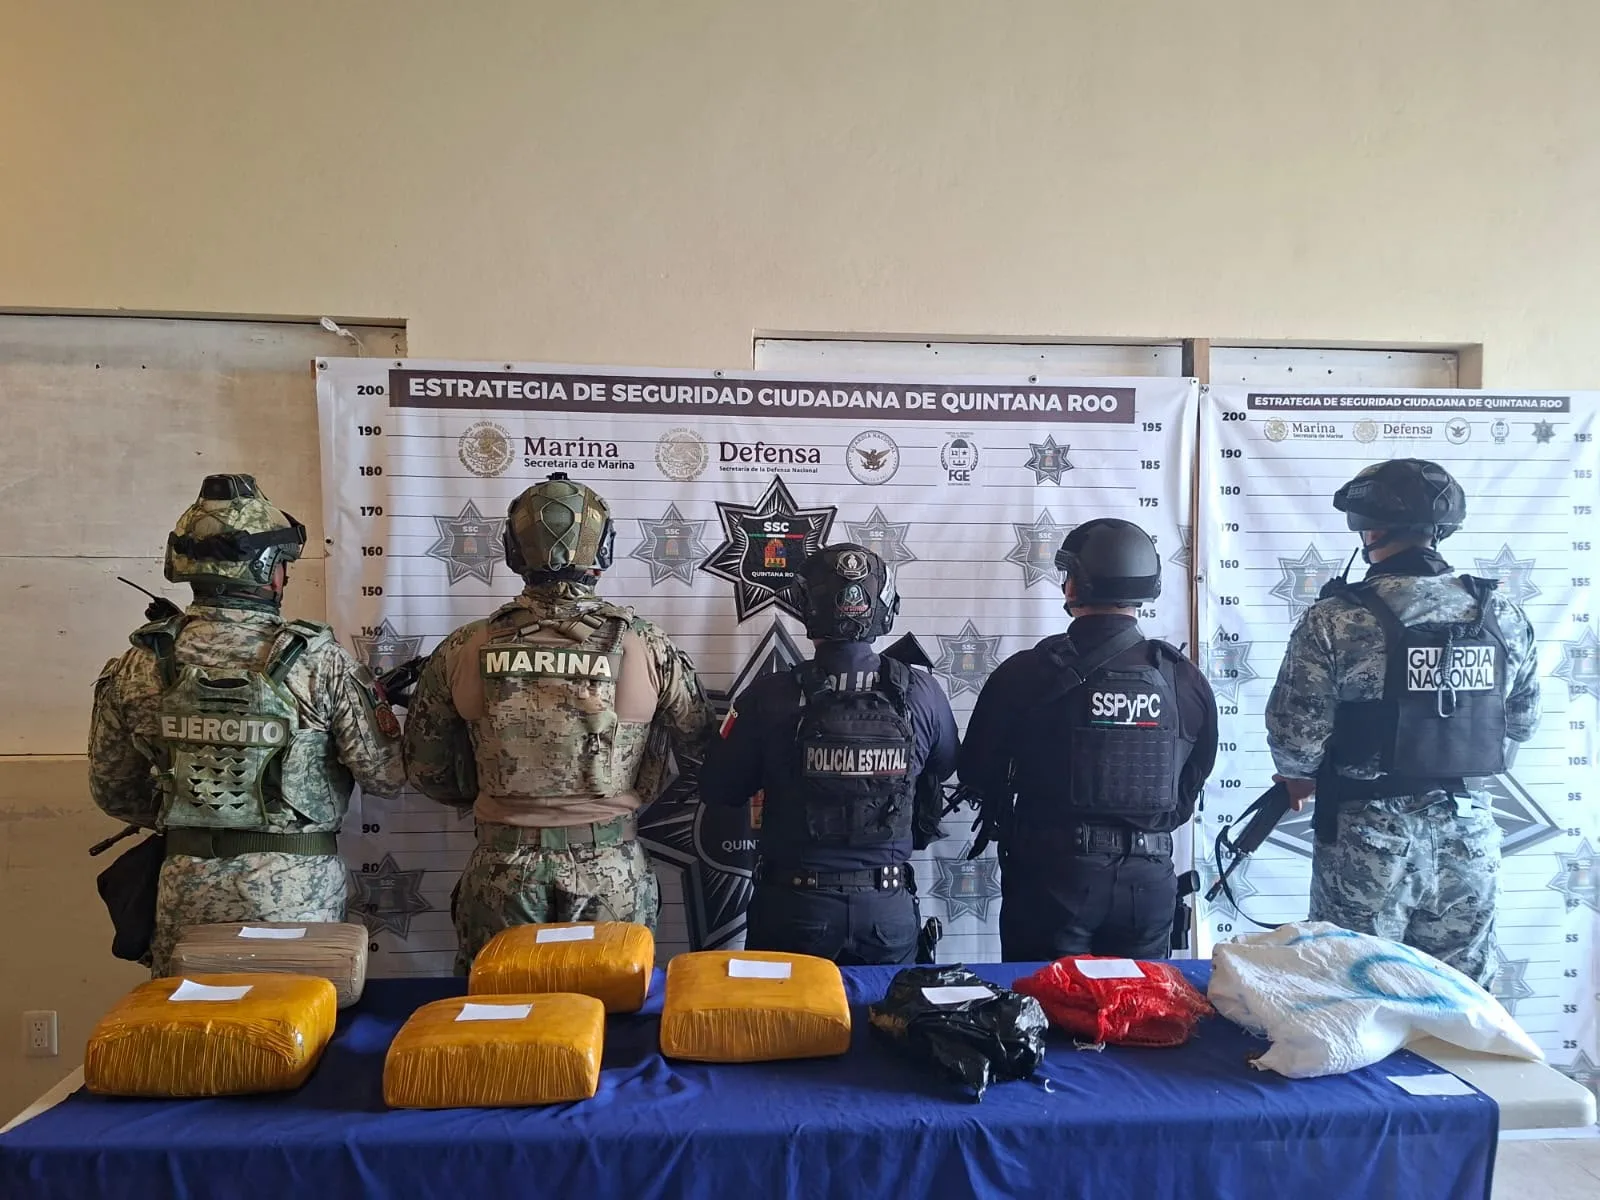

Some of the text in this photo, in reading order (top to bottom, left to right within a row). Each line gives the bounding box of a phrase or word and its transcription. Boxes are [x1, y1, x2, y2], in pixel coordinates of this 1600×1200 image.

[357, 385, 384, 395] 200
[409, 378, 1118, 413] ESTRATEGIA DE SEGURIDAD CIUDADANA DE QUINTANA ROO
[1255, 396, 1563, 409] ESTRATEGIA DE SEGURIDAD CIUDADANA DE QUINTANA ROO
[1222, 412, 1246, 421] 200
[358, 426, 381, 435] 190
[1142, 422, 1162, 432] 195
[1292, 422, 1335, 433] Marina
[1383, 423, 1432, 434] Defensa
[1574, 434, 1592, 442] 195
[524, 437, 618, 457] Marina
[719, 441, 821, 463] Defensa
[1220, 449, 1242, 458] 190
[581, 459, 595, 468] de
[598, 459, 635, 469] Marina
[1141, 460, 1160, 470] 185
[359, 466, 382, 476] 180
[949, 470, 970, 481] FGE
[1573, 470, 1592, 478] 185
[1220, 486, 1240, 495] 180
[1139, 497, 1158, 507] 175
[360, 507, 383, 516] 170
[1573, 506, 1592, 514] 175
[462, 525, 479, 533] SSC
[764, 521, 789, 533] SSC
[1221, 523, 1239, 532] 170
[1572, 542, 1591, 550] 165
[361, 546, 383, 556] 160
[1220, 560, 1239, 568] 160
[1571, 578, 1590, 586] 155
[362, 586, 383, 596] 150
[1220, 596, 1240, 605] 150
[1137, 609, 1156, 618] 145
[1572, 614, 1589, 622] 145
[361, 626, 382, 636] 140
[1219, 633, 1239, 641] 140
[487, 651, 611, 677] MARINA
[1219, 669, 1238, 678] 130
[1409, 669, 1492, 688] NACONAL
[1570, 686, 1588, 694] 125
[1092, 692, 1160, 722] SSPyPC
[1219, 706, 1238, 715] 120
[1569, 721, 1584, 729] 115
[1219, 743, 1237, 751] 110
[807, 746, 907, 771] POLICÍA ESTATAL
[1568, 757, 1587, 765] 105
[1220, 780, 1241, 788] 100
[1568, 793, 1581, 801] 95
[1218, 815, 1233, 823] 90
[362, 824, 380, 833] 90
[722, 840, 758, 852] QUIN
[362, 863, 379, 873] 80
[1217, 923, 1232, 932] 60
[1565, 934, 1578, 942] 55
[1564, 970, 1577, 978] 45
[1563, 1005, 1577, 1013] 35
